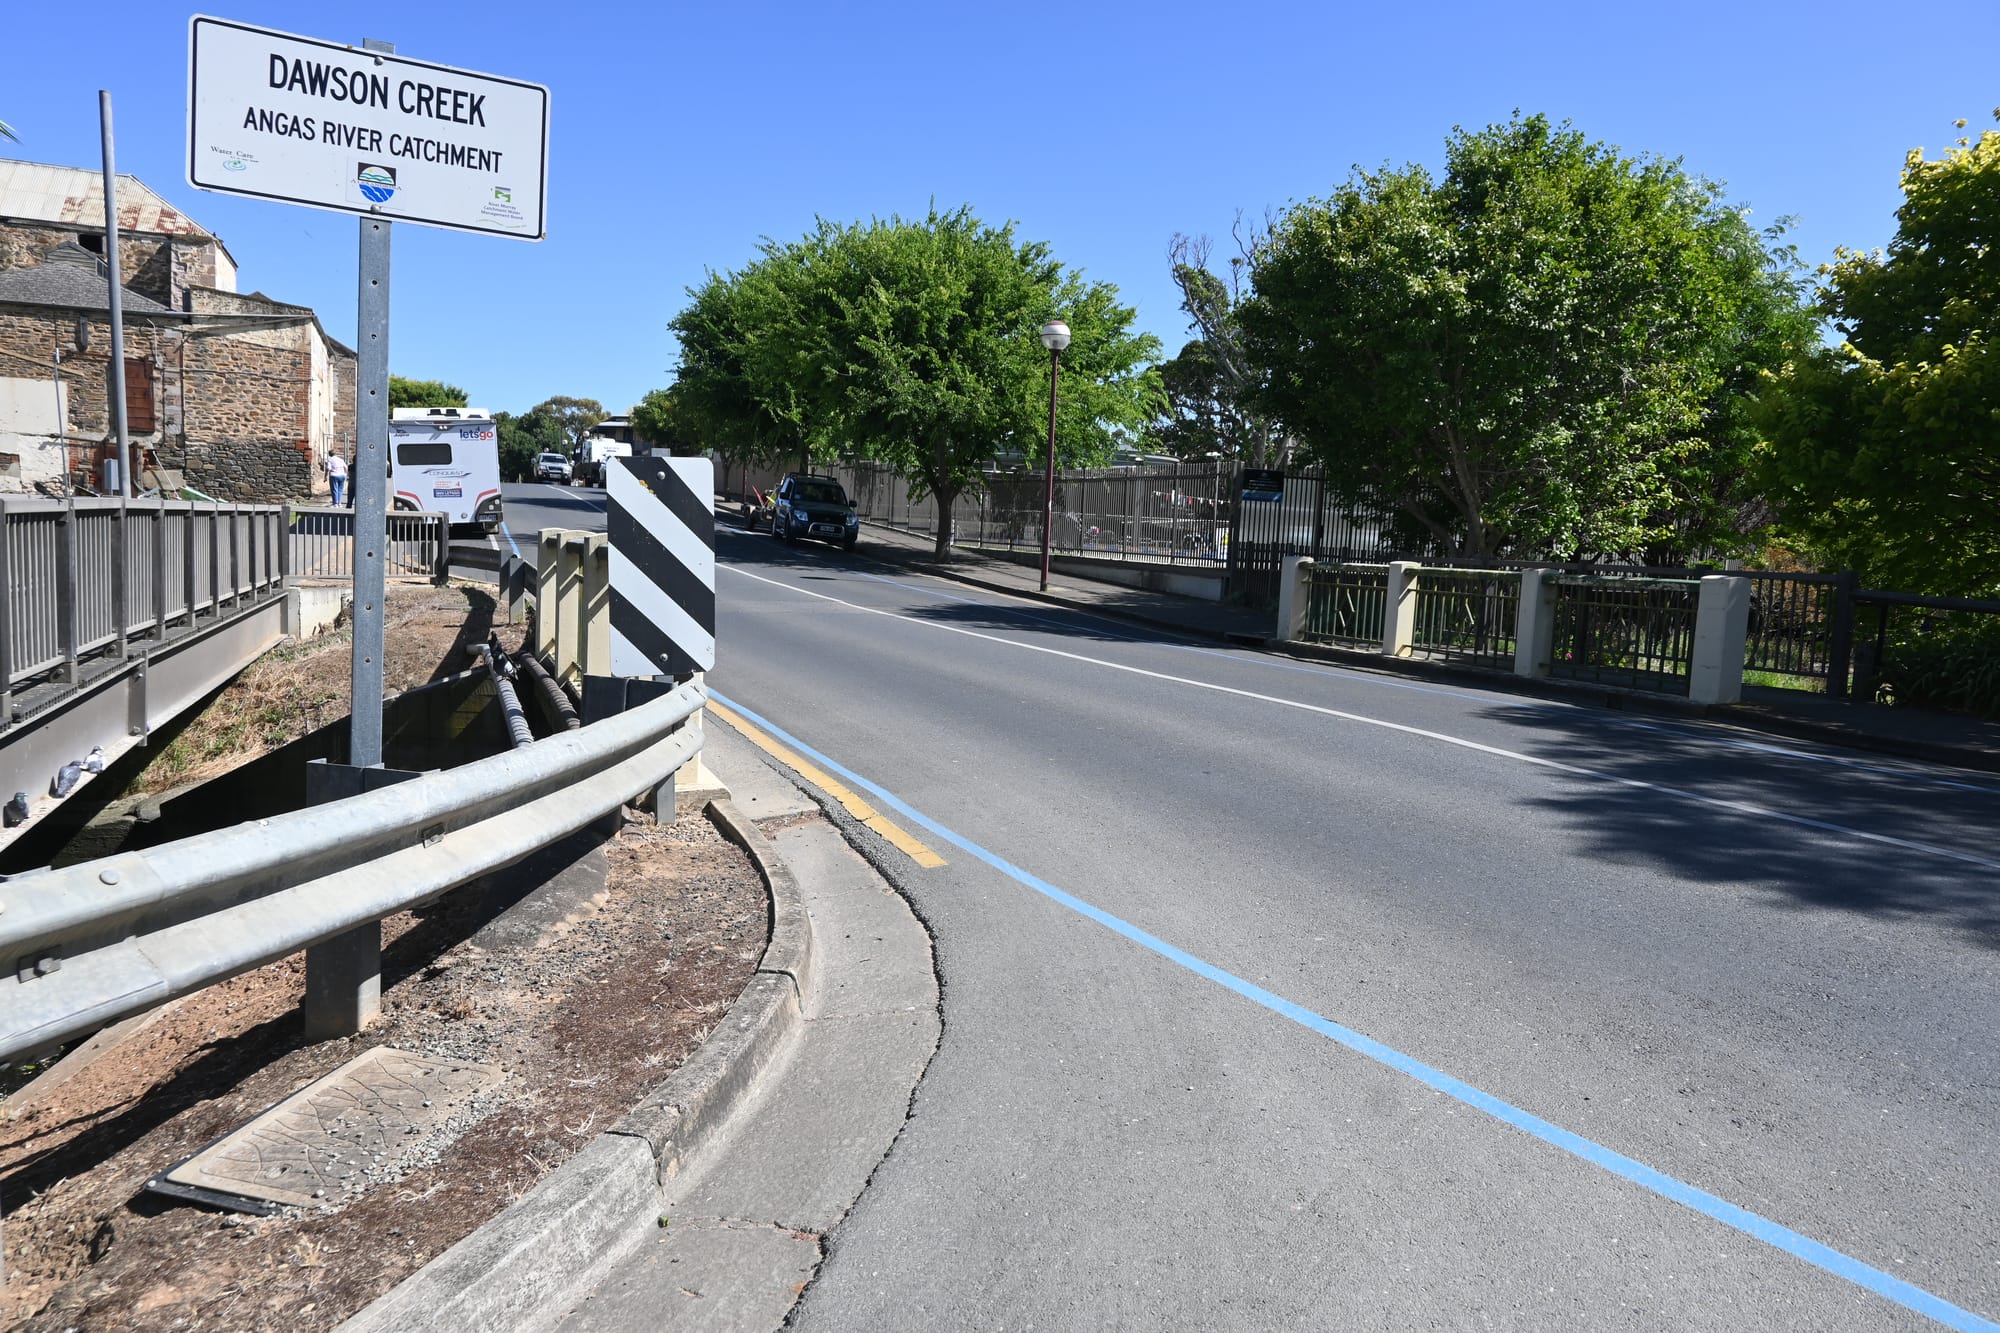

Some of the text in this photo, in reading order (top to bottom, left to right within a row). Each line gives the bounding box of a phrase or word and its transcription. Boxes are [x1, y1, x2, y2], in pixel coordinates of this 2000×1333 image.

[270, 54, 486, 127] DAWSON CREEK
[243, 106, 503, 173] ANGAS RIVER CATCHMENT
